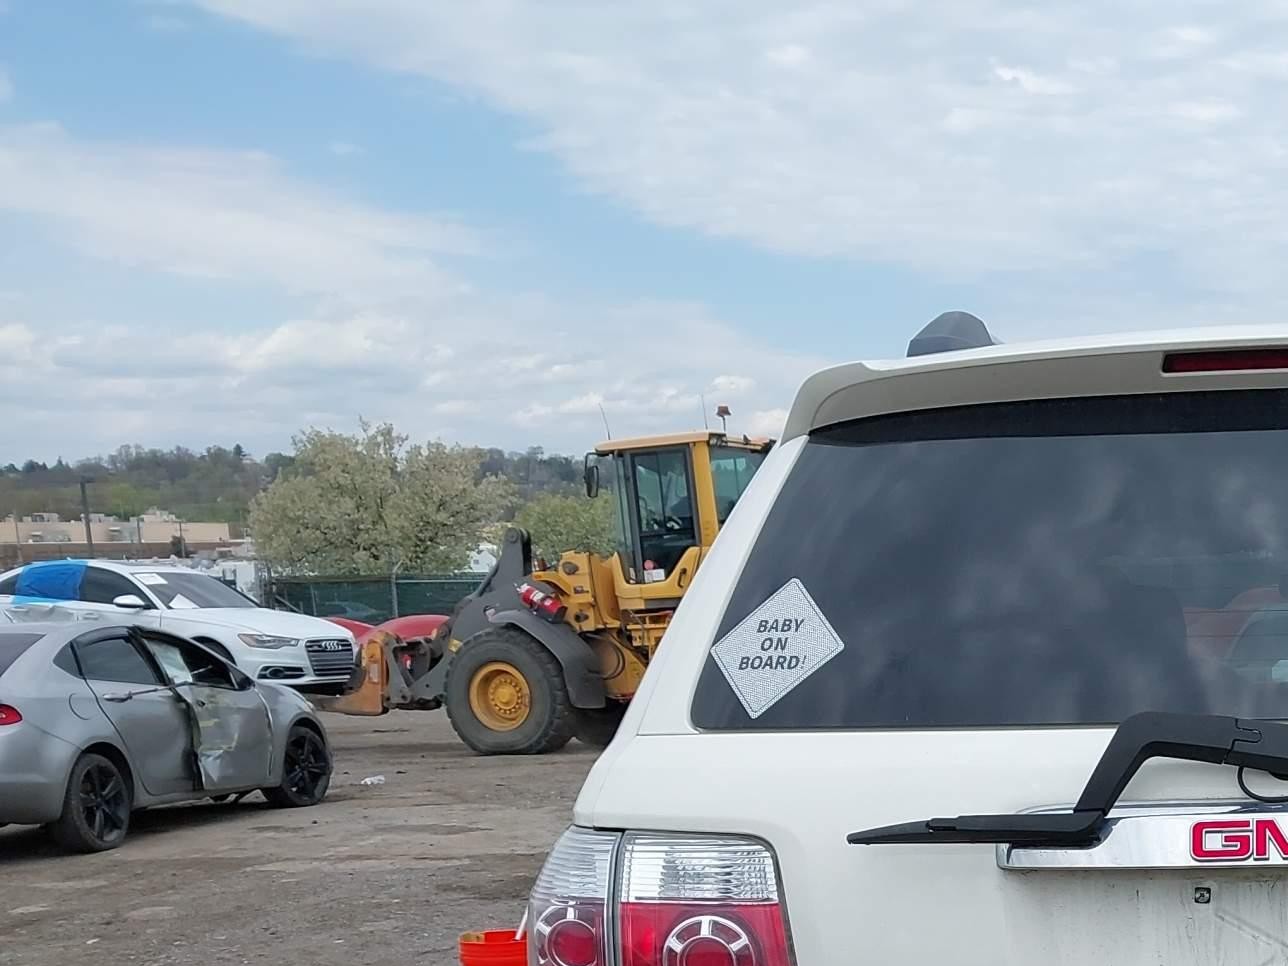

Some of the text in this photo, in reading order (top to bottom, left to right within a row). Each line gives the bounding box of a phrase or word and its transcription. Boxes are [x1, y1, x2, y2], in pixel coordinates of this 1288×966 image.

[756, 619, 804, 633] BABY
[760, 637, 788, 651] ON
[738, 655, 807, 670] BOARD!
